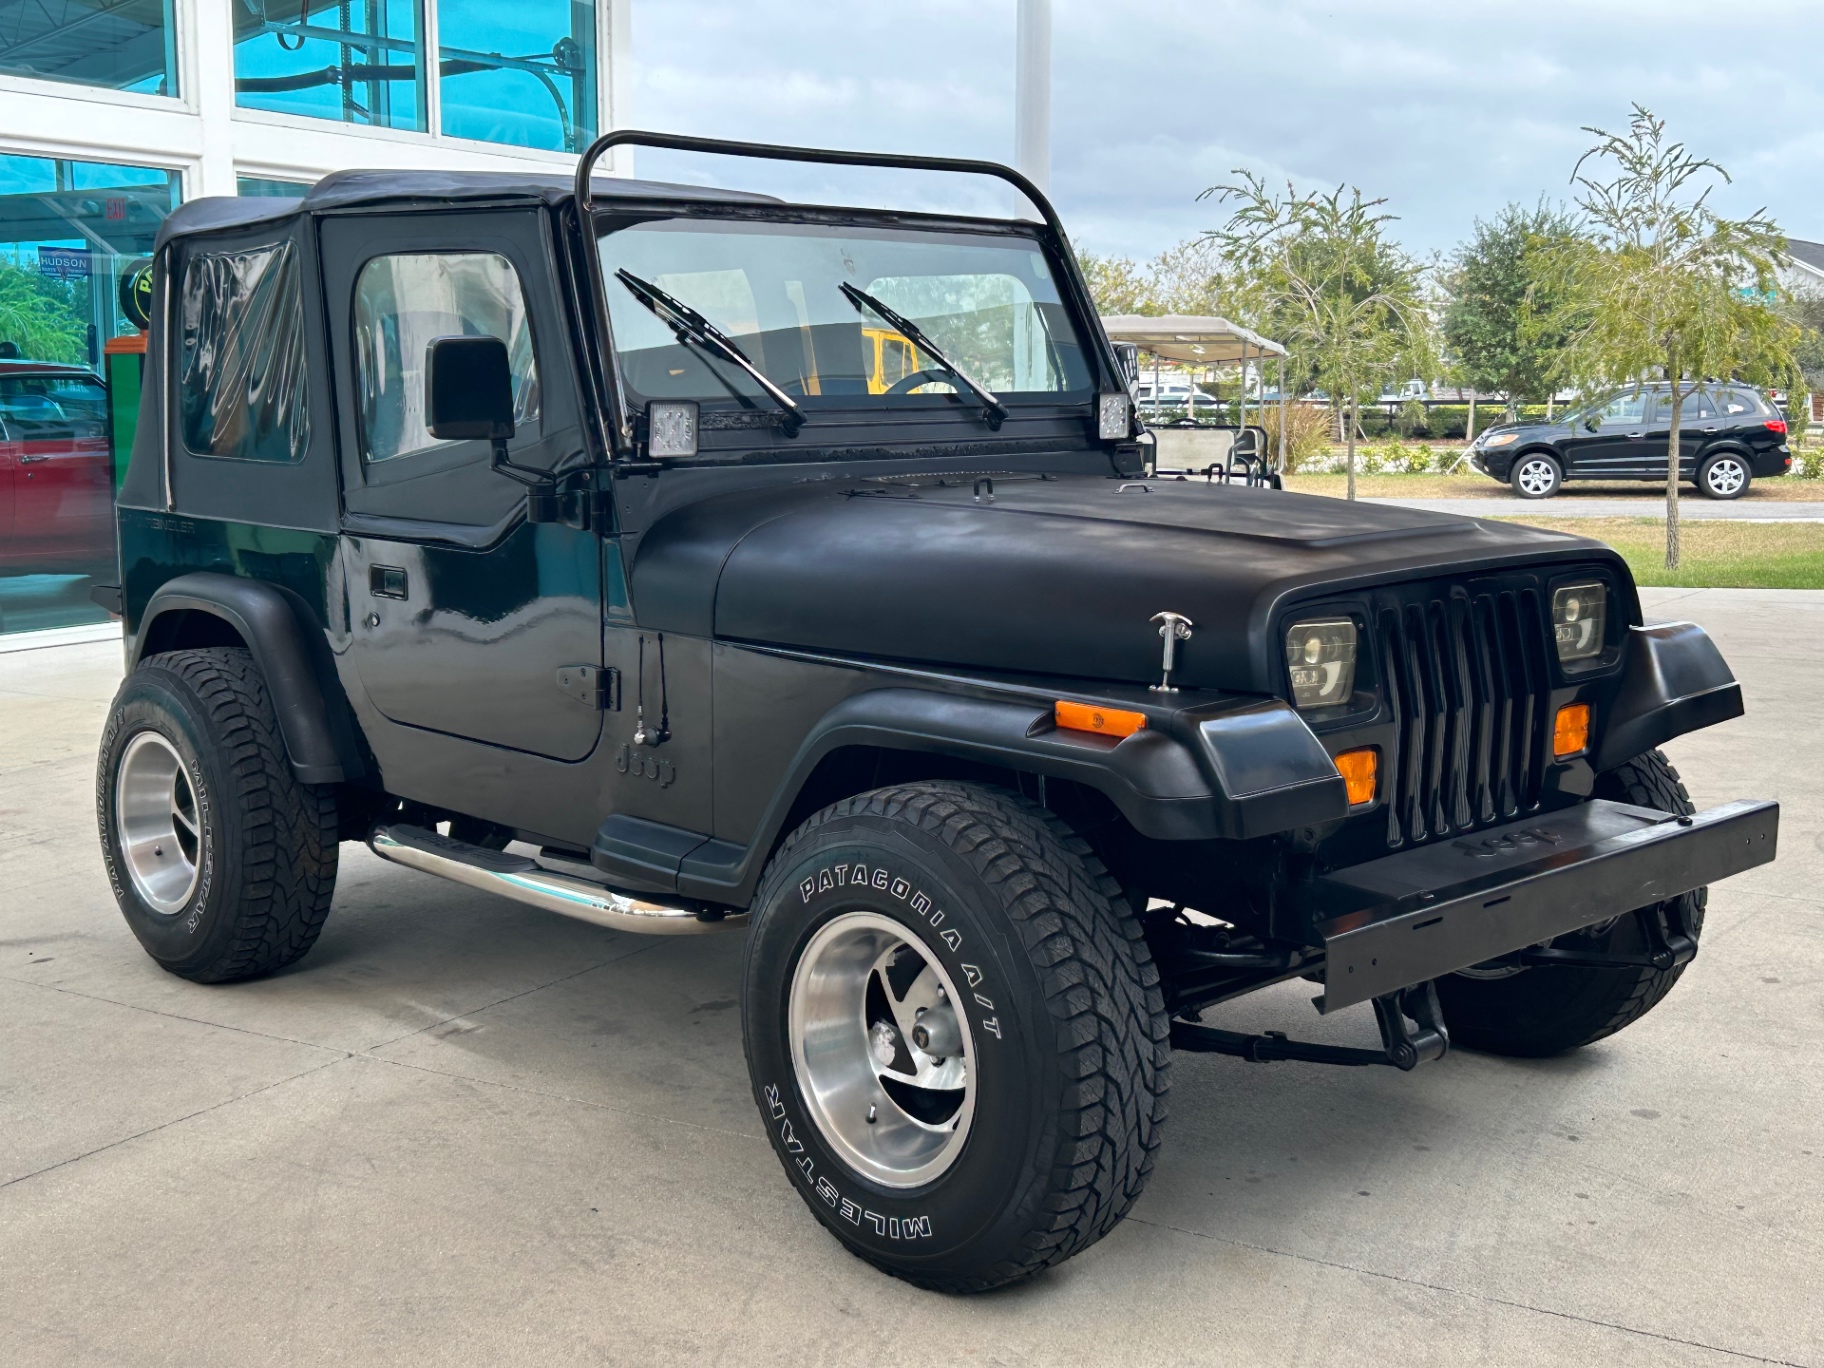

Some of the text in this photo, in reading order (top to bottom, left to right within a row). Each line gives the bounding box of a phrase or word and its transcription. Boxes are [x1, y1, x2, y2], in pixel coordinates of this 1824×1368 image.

[106, 198, 126, 220] EXIT
[41, 256, 87, 268] HUDSON
[800, 864, 1002, 1040] PATAGONIA A/T
[764, 1082, 932, 1240] MILESTAR
